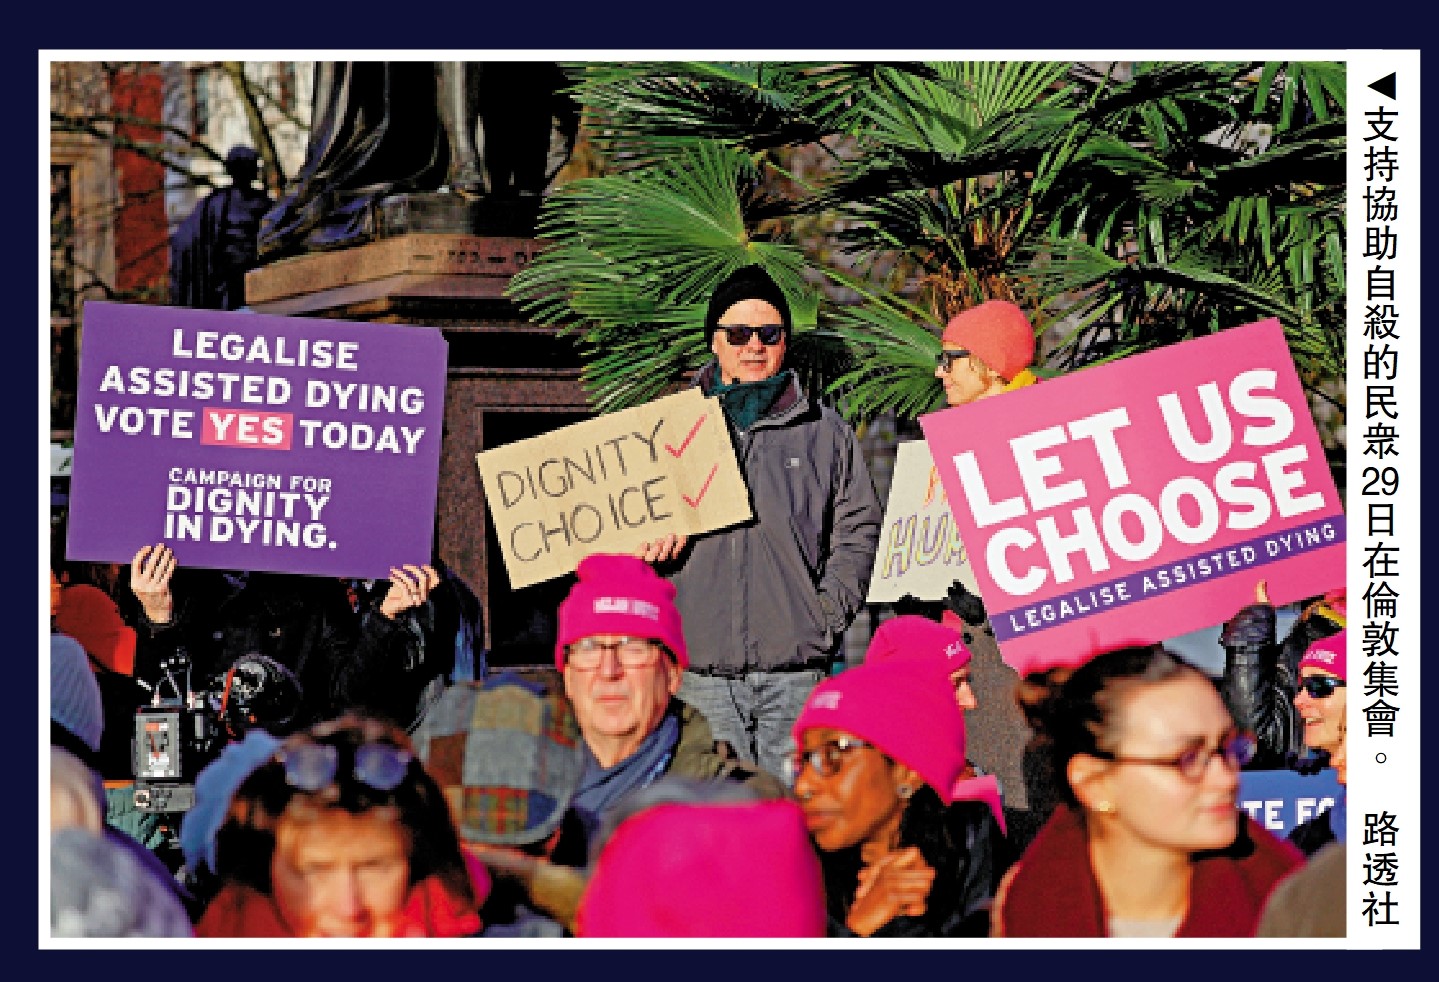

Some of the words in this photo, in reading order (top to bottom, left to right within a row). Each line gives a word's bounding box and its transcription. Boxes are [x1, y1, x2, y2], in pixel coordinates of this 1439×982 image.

[172, 328, 360, 371] LEGALISE
[100, 366, 292, 405] ASSISTED
[305, 380, 425, 414] DYING
[94, 404, 194, 438] VOTE
[209, 412, 285, 444] YES
[299, 420, 426, 455] TODAY
[951, 407, 1132, 528] LET
[1158, 368, 1295, 463] US
[168, 467, 281, 490] CAMPAIGN
[290, 475, 332, 493] FOR
[496, 417, 664, 510] DIGNITY
[166, 486, 330, 520] DIGNITY
[510, 475, 673, 563] CHOICE
[985, 444, 1326, 596] CHOOSE
[164, 515, 201, 541] IN
[209, 517, 337, 550] DYING.
[1009, 583, 1131, 632] LEGALISE
[1142, 546, 1257, 594] ASSISTED
[1265, 523, 1337, 558] DYING
[1238, 800, 1284, 830] TE
